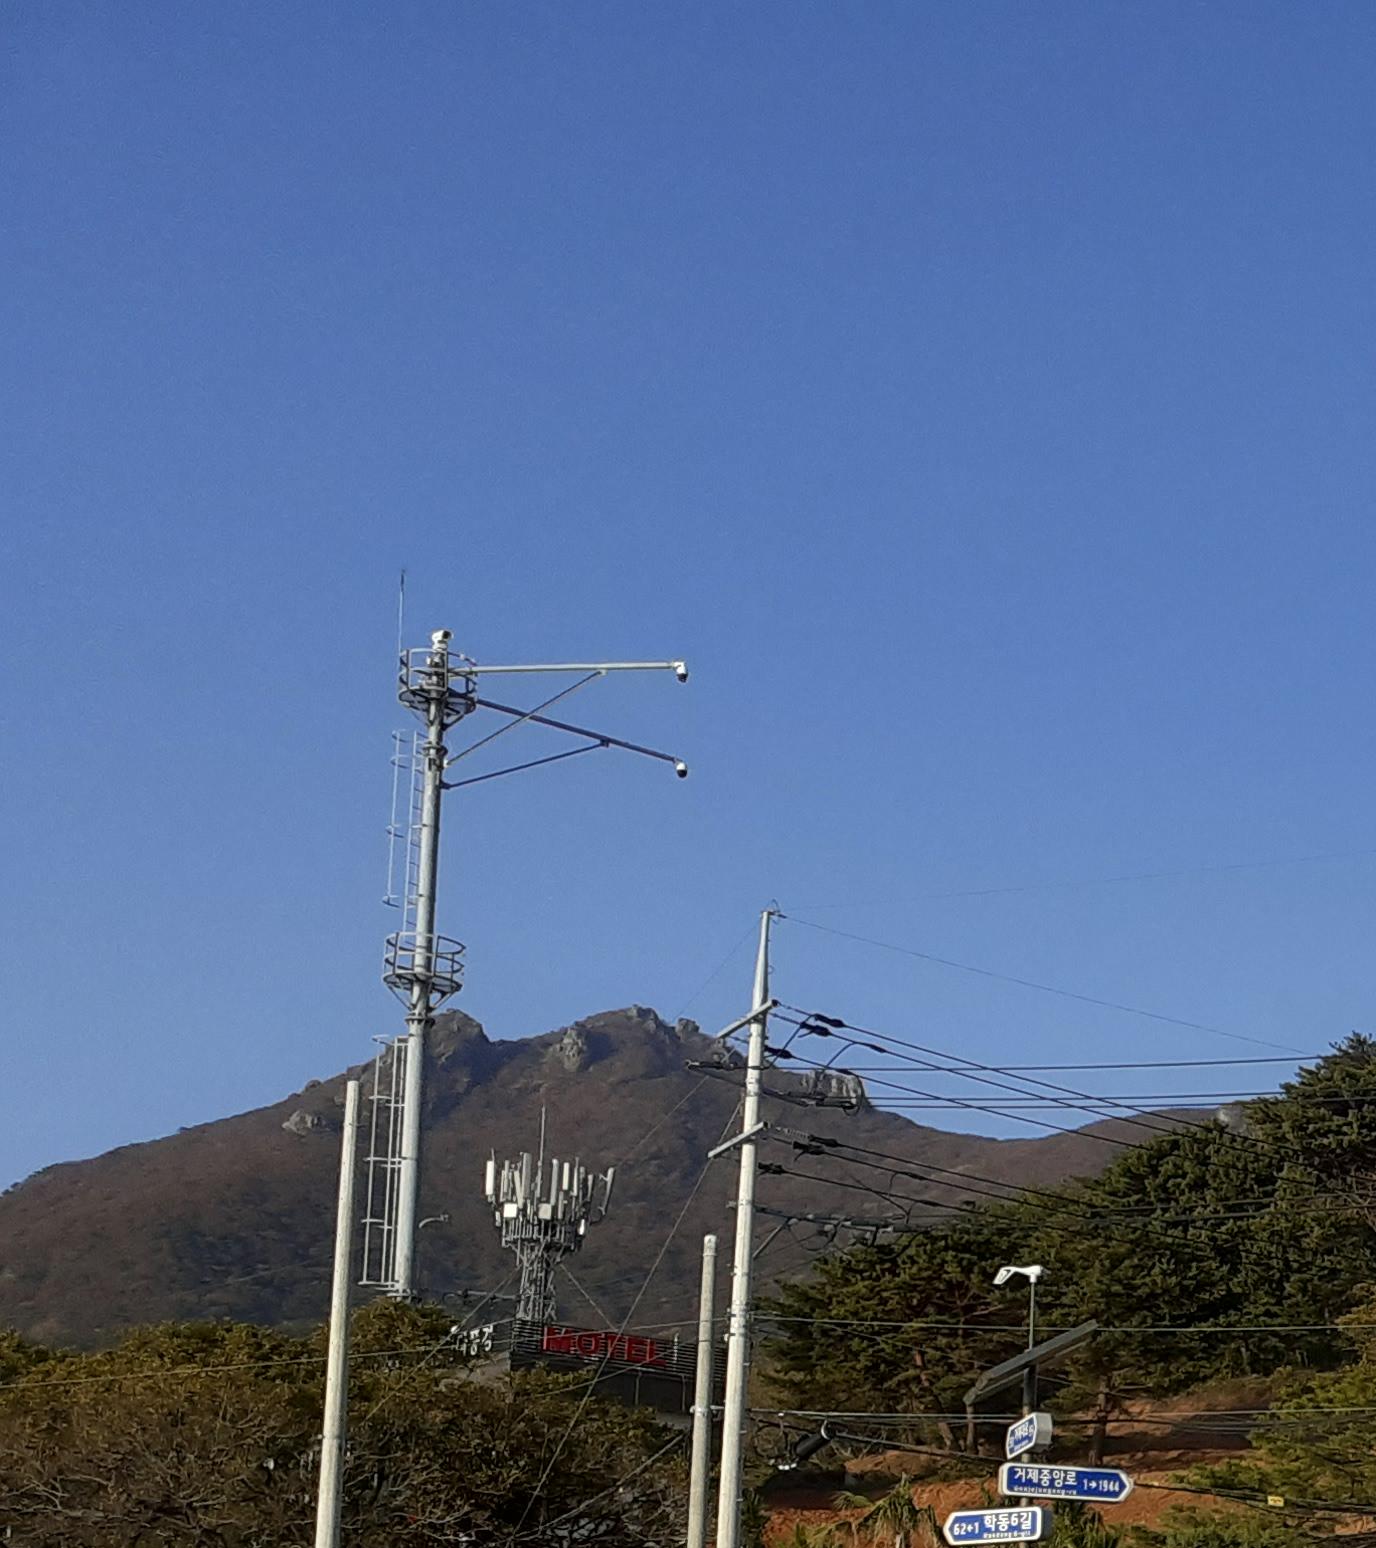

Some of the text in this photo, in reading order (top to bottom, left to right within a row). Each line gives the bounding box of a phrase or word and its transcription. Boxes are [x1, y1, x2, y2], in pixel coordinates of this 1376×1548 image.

[542, 1326, 667, 1366] MOTEL
[1014, 1468, 1077, 1487] 거제중앙로
[983, 1512, 1032, 1532] 학동6길
